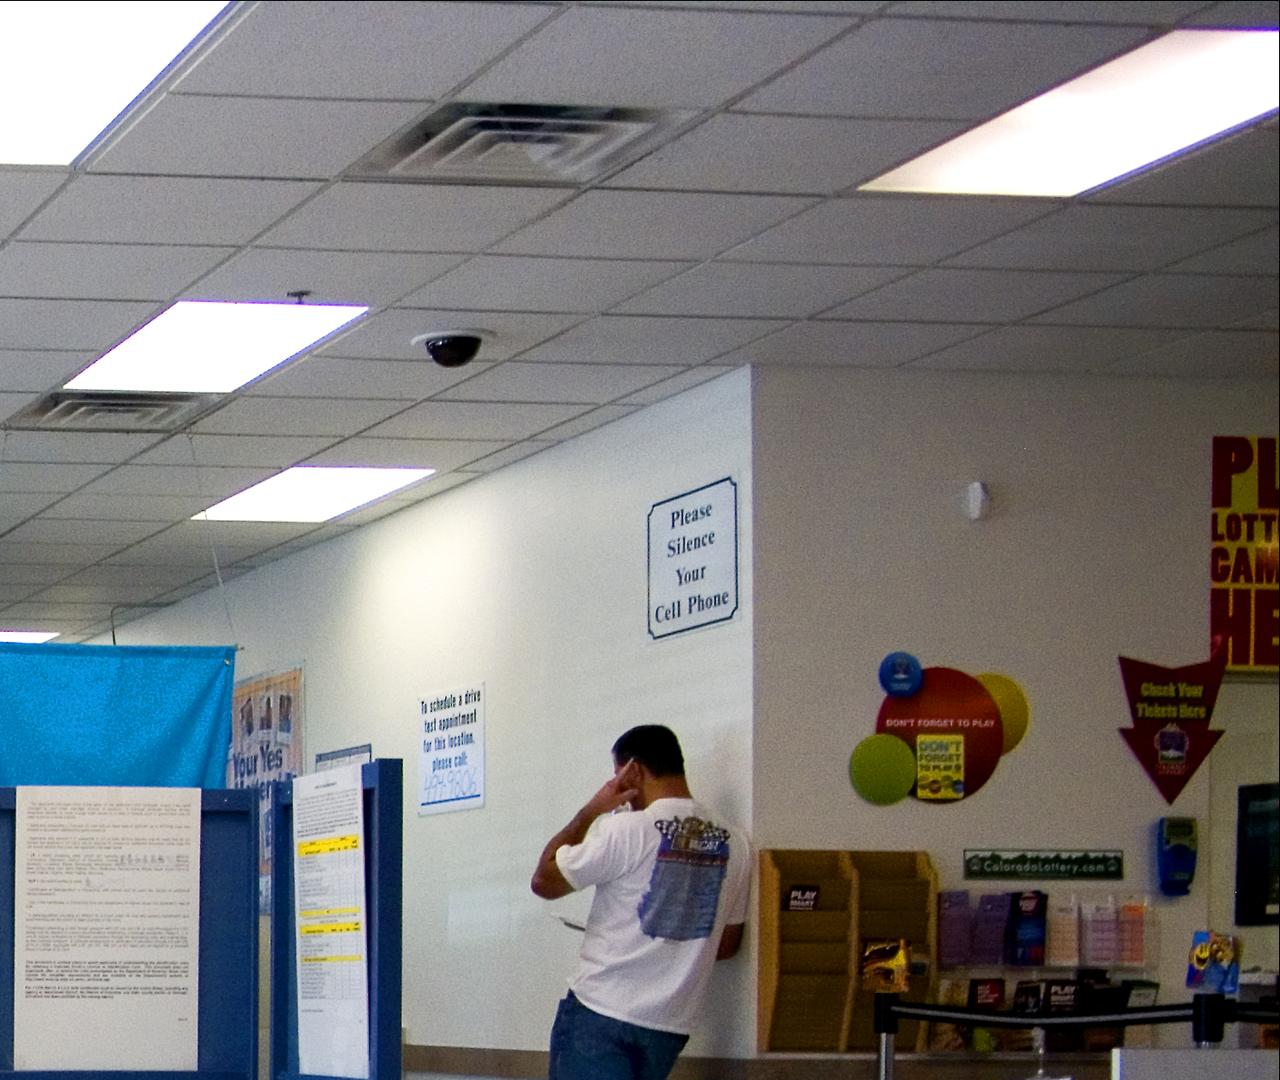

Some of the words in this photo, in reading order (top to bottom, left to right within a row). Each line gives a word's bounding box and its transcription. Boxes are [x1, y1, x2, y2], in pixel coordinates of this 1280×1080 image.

[670, 503, 713, 530] Please
[667, 531, 715, 558] Silence
[676, 565, 706, 587] Your
[655, 600, 681, 624] Cell
[688, 591, 730, 615] Phone
[1141, 682, 1177, 698] Check
[1177, 682, 1204, 698] Your
[421, 701, 428, 715] To
[430, 694, 456, 713] schedule
[458, 695, 462, 706] a
[464, 689, 481, 705] drive
[1136, 702, 1178, 718] Tickets
[1178, 703, 1206, 718] Here
[424, 717, 437, 734] test
[439, 708, 477, 732] appointment
[886, 719, 914, 727] DON'T
[918, 719, 954, 727] FORGET
[958, 719, 970, 728] TO
[972, 719, 995, 727] PLAY
[423, 739, 432, 753] for
[434, 736, 446, 751] this
[233, 753, 258, 779] Your
[260, 743, 283, 772] Yes
[432, 757, 452, 773] please
[919, 753, 962, 763] FORGET
[983, 861, 1105, 874] ColoradoLottery.com
[790, 889, 817, 900] PLAY
[1050, 985, 1076, 995] PLAY
